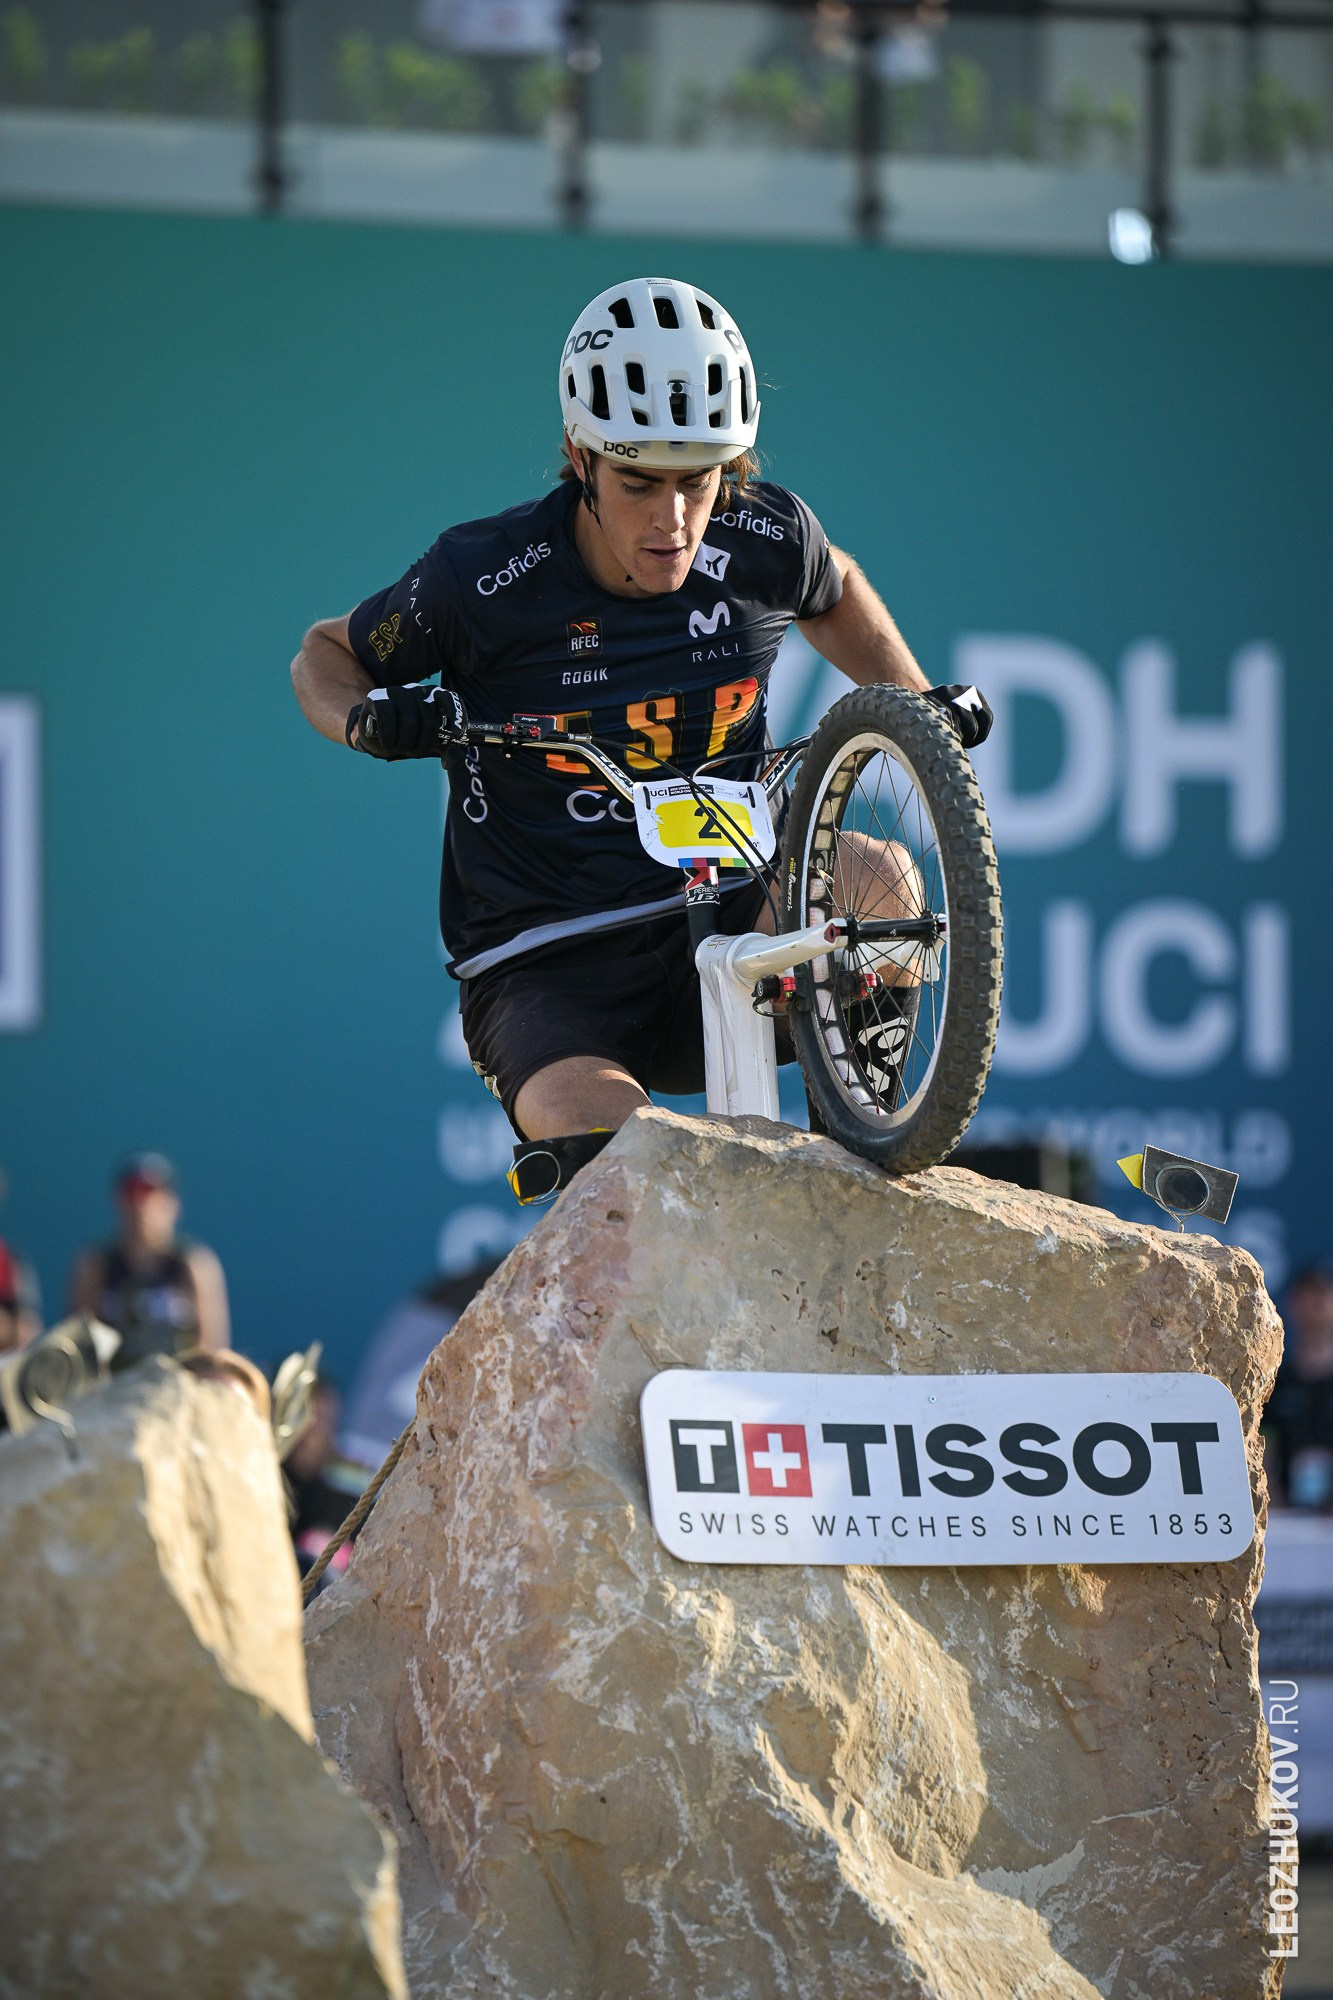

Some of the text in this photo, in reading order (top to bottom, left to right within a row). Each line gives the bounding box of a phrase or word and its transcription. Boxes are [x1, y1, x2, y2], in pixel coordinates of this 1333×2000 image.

[476, 541, 551, 596] Cofidis
[571, 634, 599, 651] RFEC
[692, 643, 739, 663] RALI
[562, 667, 609, 685] GOBIK
[650, 789, 668, 797] UCI
[694, 806, 722, 839] 2
[821, 1421, 1220, 1498] TISSOT
[679, 1512, 1233, 1538] SWISS WATCHES SINCE 1853
